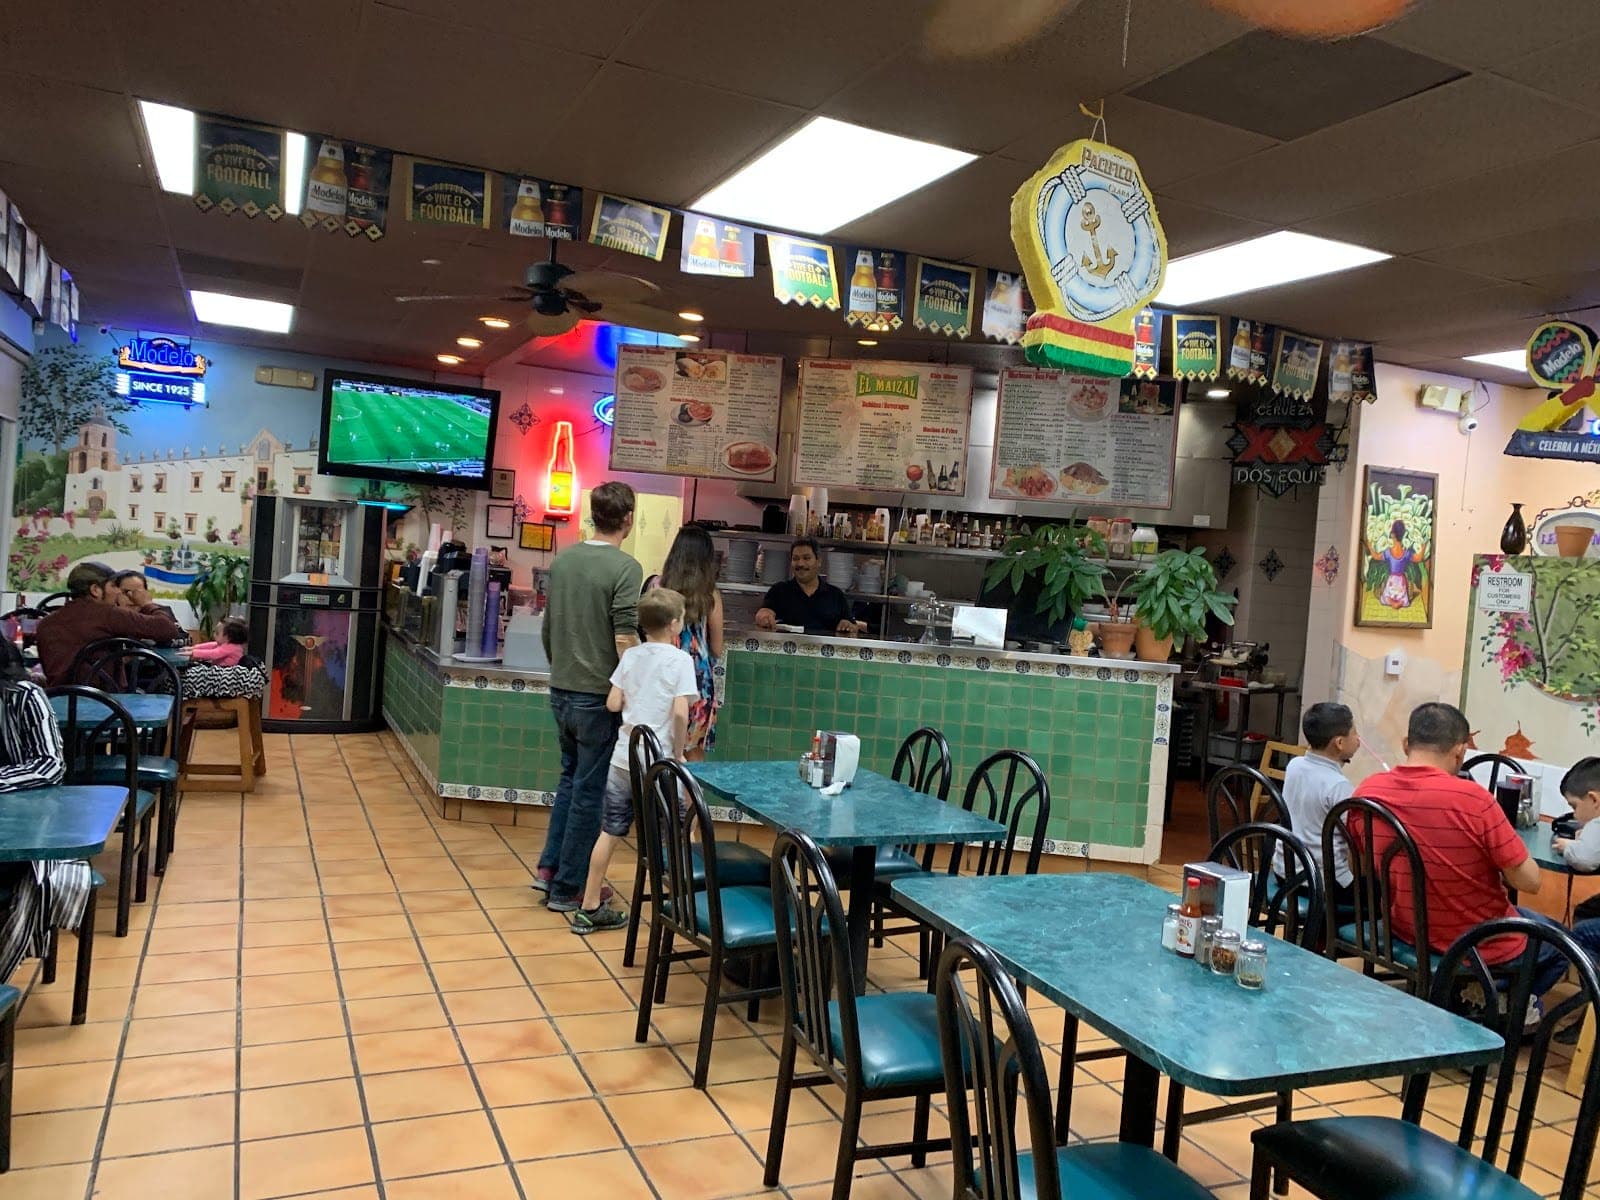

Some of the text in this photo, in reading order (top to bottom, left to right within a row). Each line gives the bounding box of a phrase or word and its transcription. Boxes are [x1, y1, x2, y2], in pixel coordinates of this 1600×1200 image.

[224, 153, 244, 168] VIVE
[1082, 147, 1132, 182] PACIFICO
[207, 163, 271, 190] FOOTBALL
[348, 191, 377, 208] Modelo
[434, 192, 452, 205] VIVE
[420, 203, 476, 224] FOOTBALL
[545, 226, 571, 239] Modelo
[934, 288, 946, 298] VIVE
[924, 295, 962, 315] FOOTBALL
[130, 339, 194, 366] Modelo
[1181, 348, 1212, 360] FOOTBALL
[1541, 342, 1581, 376] Modelo
[132, 381, 190, 396] SINCE 1925
[859, 375, 872, 394] EL
[876, 379, 917, 398] MAIZAL
[1257, 405, 1314, 416] CERVEZA
[1538, 440, 1572, 453] CELEBRA
[1573, 442, 1579, 453] A
[1237, 468, 1272, 483] DOS
[1487, 576, 1523, 587] RESTROOM
[1487, 592, 1521, 600] CUSTOMERS
